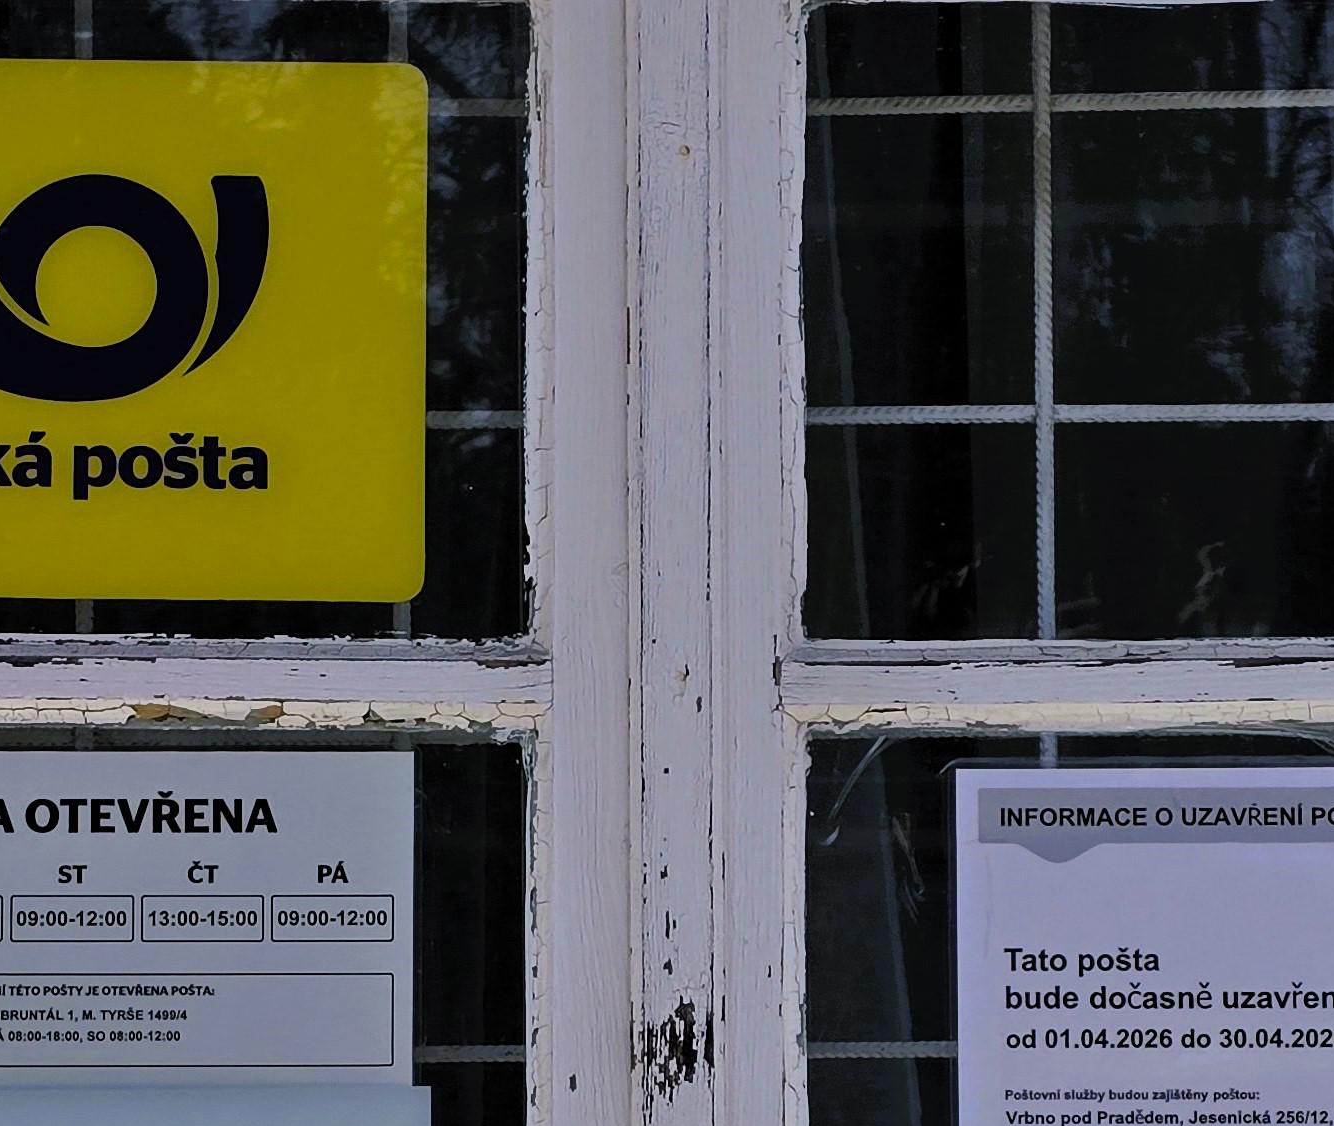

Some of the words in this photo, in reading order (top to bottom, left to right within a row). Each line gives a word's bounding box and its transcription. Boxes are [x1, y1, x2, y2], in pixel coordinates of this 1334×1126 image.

[72, 432, 269, 501] pošta
[24, 790, 278, 834] OTEVŘENA
[1000, 807, 1148, 827] INFORMACE
[1155, 807, 1174, 827] O
[1181, 802, 1303, 827] UZAVŘENÍ
[57, 864, 88, 884] ST
[187, 860, 220, 884] ČT
[317, 860, 349, 884] PÁ
[16, 910, 127, 927] 09:00-12:00
[148, 909, 258, 927] 13:00-15:00
[277, 909, 388, 927] 09:00-12:00
[1003, 947, 1068, 972] Tato
[1078, 947, 1160, 978] pošta
[8, 983, 41, 997] TÉTO
[42, 983, 84, 997] POŠTY
[84, 985, 100, 997] JE
[101, 983, 169, 997] OTEVŘENA
[170, 983, 215, 997] POŠTA:
[1005, 985, 1079, 1010] bude
[1089, 981, 1213, 1010] dočasně
[0, 1007, 65, 1021] BRUNTÁL
[67, 1009, 79, 1023] 1,
[81, 1009, 97, 1021] M.
[99, 1006, 144, 1021] TYRŠE
[147, 1009, 188, 1021] 1499/4
[7, 1030, 83, 1044] 08:00-18:00,
[86, 1030, 106, 1042] SO
[109, 1030, 181, 1042] 08:00-12:00
[1006, 1028, 1037, 1049] od
[1044, 1028, 1173, 1049] 01.04.2026
[1180, 1028, 1212, 1049] do
[1004, 1087, 1061, 1101] Poštovní
[1063, 1088, 1106, 1103] služby
[1108, 1089, 1149, 1101] budou
[1152, 1088, 1209, 1103] zajištěny
[1213, 1087, 1260, 1103] poštou:
[1005, 1110, 1056, 1125] Vrbno
[1097, 1109, 1184, 1126] Pradědem,
[1188, 1109, 1272, 1125] Jesenická
[1276, 1110, 1334, 1126] 256/12,
